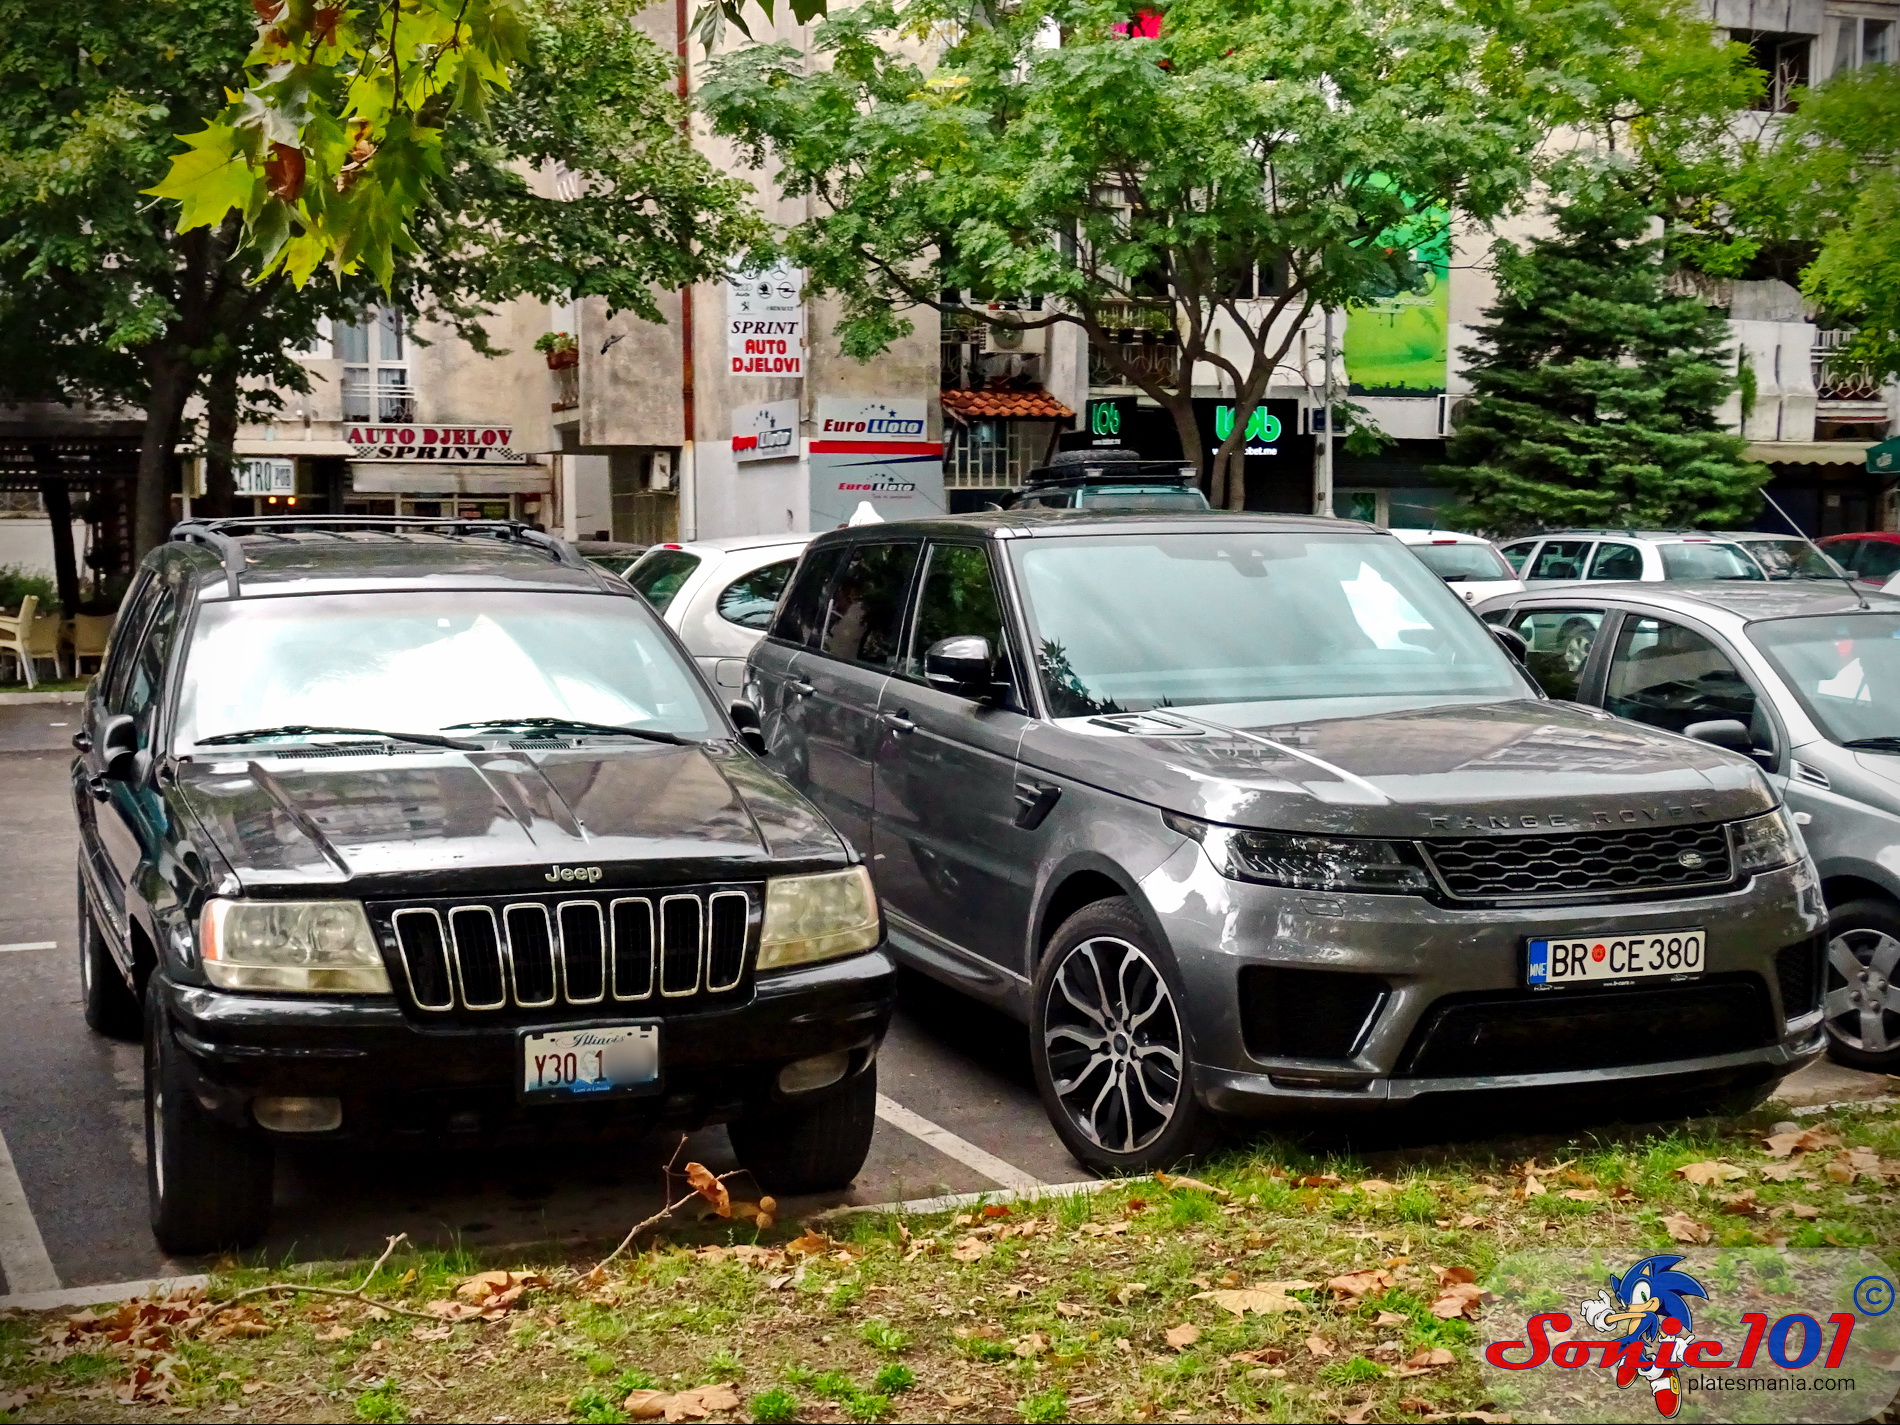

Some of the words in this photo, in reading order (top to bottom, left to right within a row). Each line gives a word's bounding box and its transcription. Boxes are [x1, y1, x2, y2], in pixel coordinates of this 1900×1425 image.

[731, 321, 799, 335] SPRINT
[745, 339, 787, 354] AUTO
[732, 357, 800, 373] DJELOVI
[823, 419, 867, 432] Euro
[350, 428, 416, 445] AUTO
[375, 446, 493, 459] SPRINT
[838, 482, 871, 491] Euro
[1429, 814, 1567, 829] RANGE
[1592, 803, 1710, 824] ROVER
[545, 865, 603, 883] Jeep
[1551, 943, 1588, 977] BR
[1530, 962, 1547, 978] MNE
[555, 1033, 626, 1049] Illinois
[534, 1053, 577, 1087] Y30
